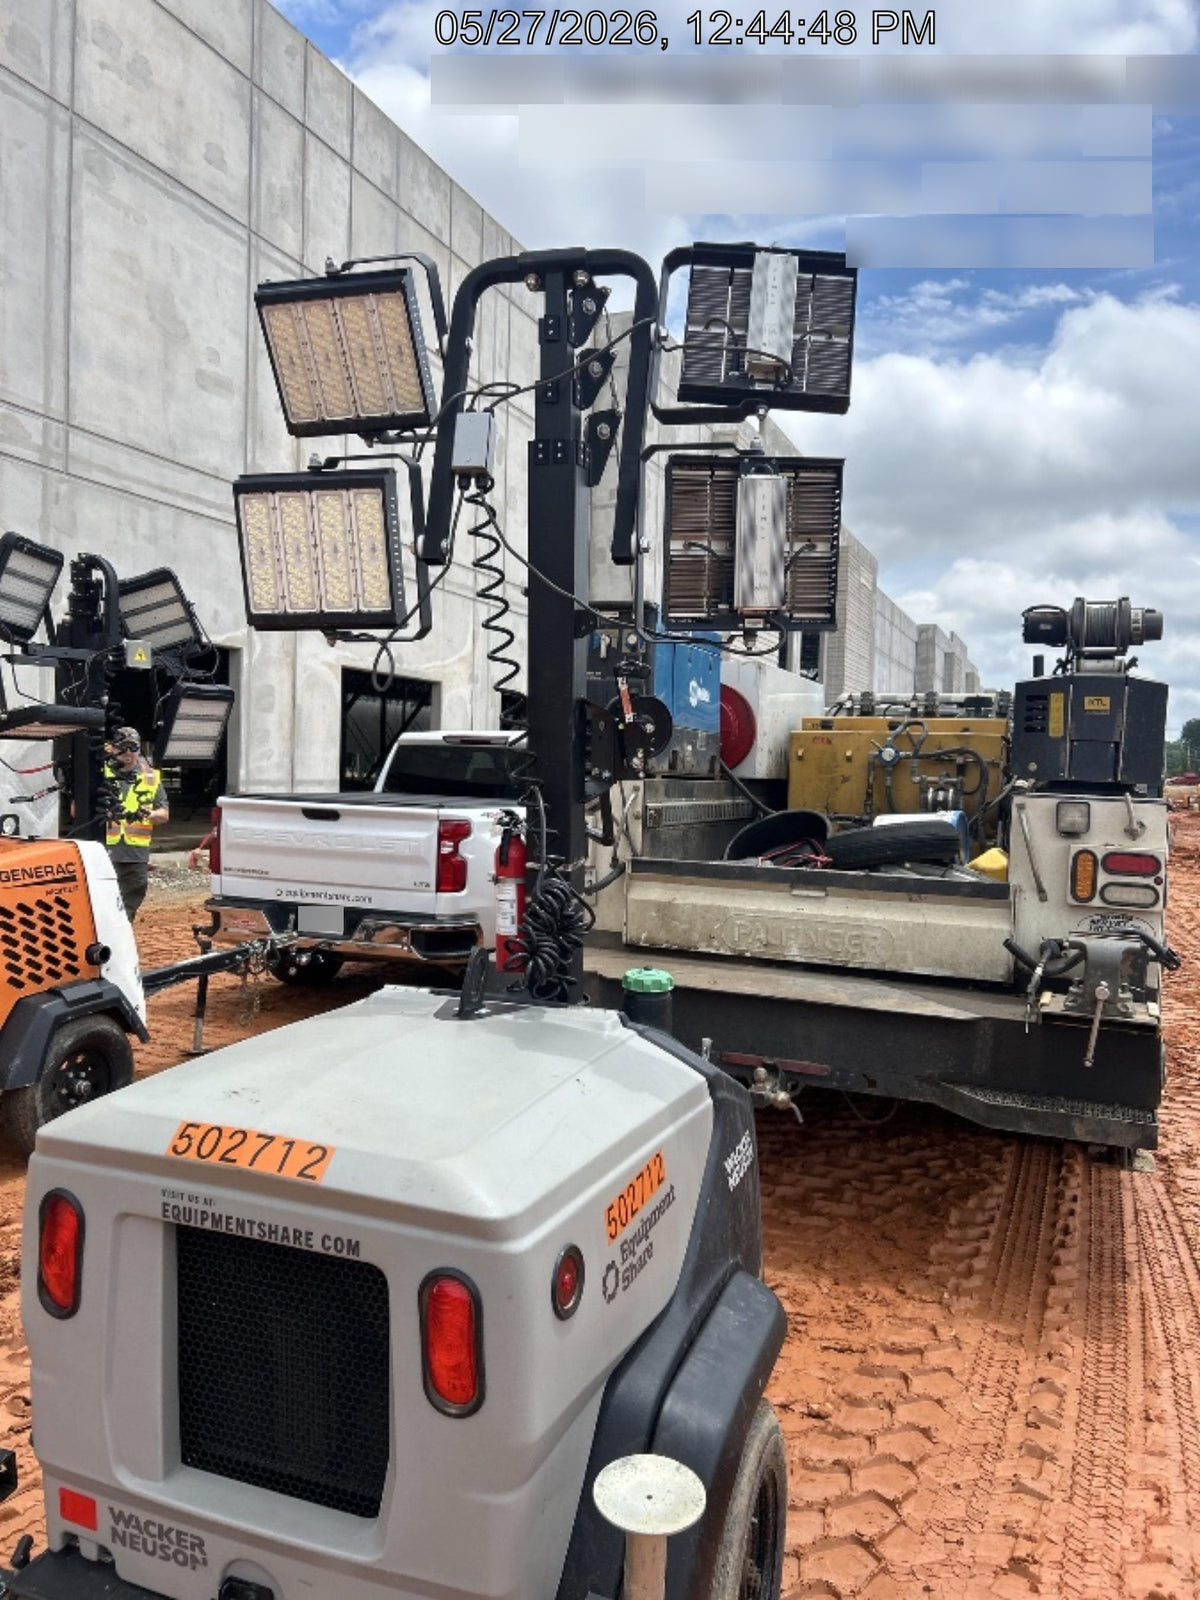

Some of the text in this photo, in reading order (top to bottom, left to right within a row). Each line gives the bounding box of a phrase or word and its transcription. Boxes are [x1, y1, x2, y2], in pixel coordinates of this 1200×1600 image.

[0, 861, 77, 883] GENERAC
[171, 1122, 328, 1181] 502712
[606, 1152, 665, 1240] 502712
[619, 1184, 676, 1265] Equipment
[621, 1241, 653, 1292] Share
[108, 1505, 207, 1557] WACKER
[110, 1526, 209, 1571] NEUSON
